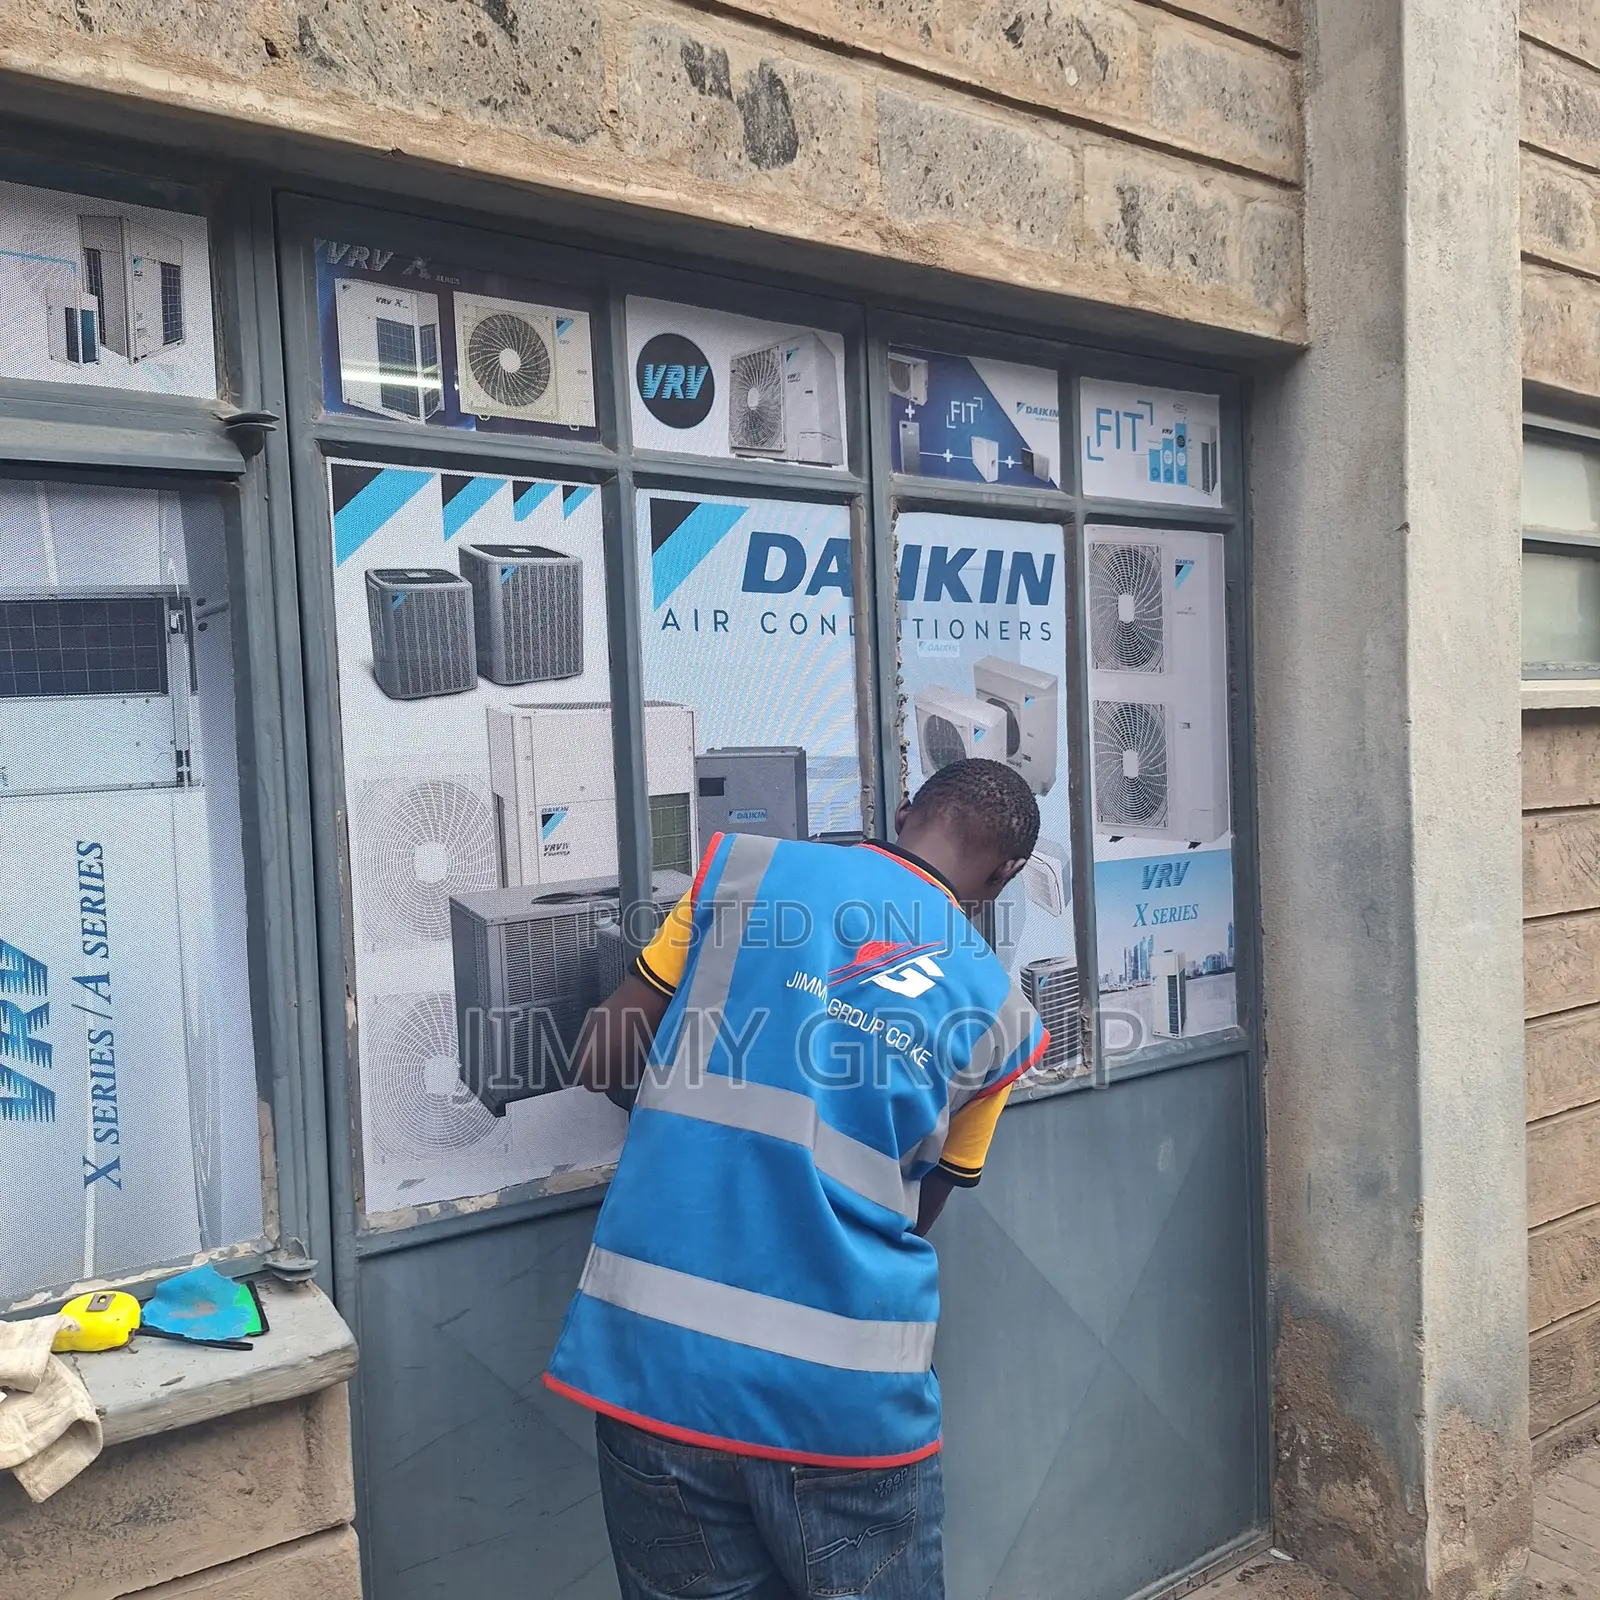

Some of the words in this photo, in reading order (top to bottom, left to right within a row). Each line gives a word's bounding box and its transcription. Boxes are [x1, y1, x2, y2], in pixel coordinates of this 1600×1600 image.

[326, 240, 394, 272] VRV
[643, 364, 709, 400] VRV
[950, 400, 978, 424] FIT
[1096, 407, 1144, 452] FIT
[741, 531, 1056, 606] DAIKIN
[661, 608, 729, 634] AIR
[1141, 861, 1190, 890] VRV
[76, 840, 109, 959] SERIES
[1133, 902, 1149, 928] X
[1151, 903, 1199, 926] SERIES
[82, 1155, 122, 1191] X
